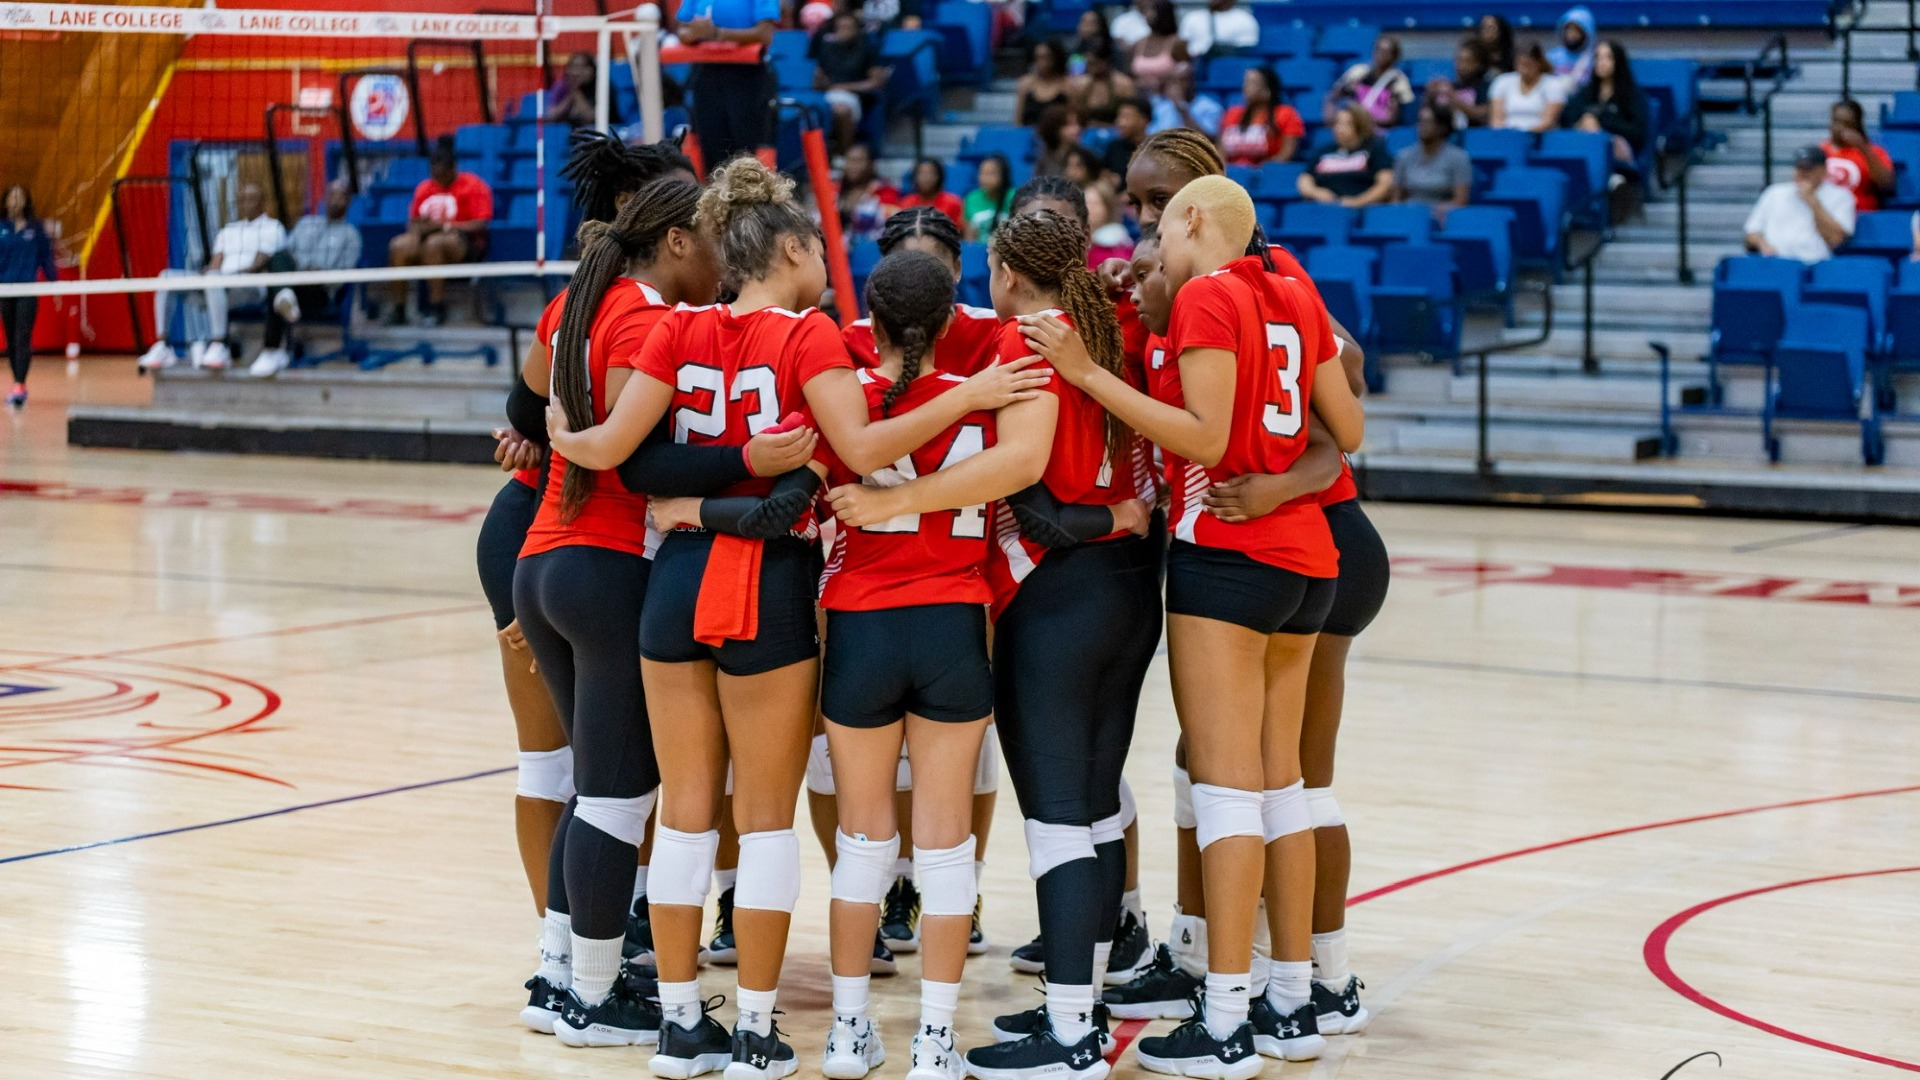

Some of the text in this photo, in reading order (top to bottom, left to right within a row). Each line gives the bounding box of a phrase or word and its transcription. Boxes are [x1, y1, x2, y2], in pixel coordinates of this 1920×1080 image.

[49, 10, 97, 26] LANE
[103, 11, 183, 28] COLLEGE
[240, 15, 283, 30] LANE
[289, 16, 360, 32] COLLEGE
[412, 20, 450, 32] LANE
[456, 20, 521, 33] COLLEGE
[1263, 321, 1303, 438] 3
[674, 361, 782, 444] 23
